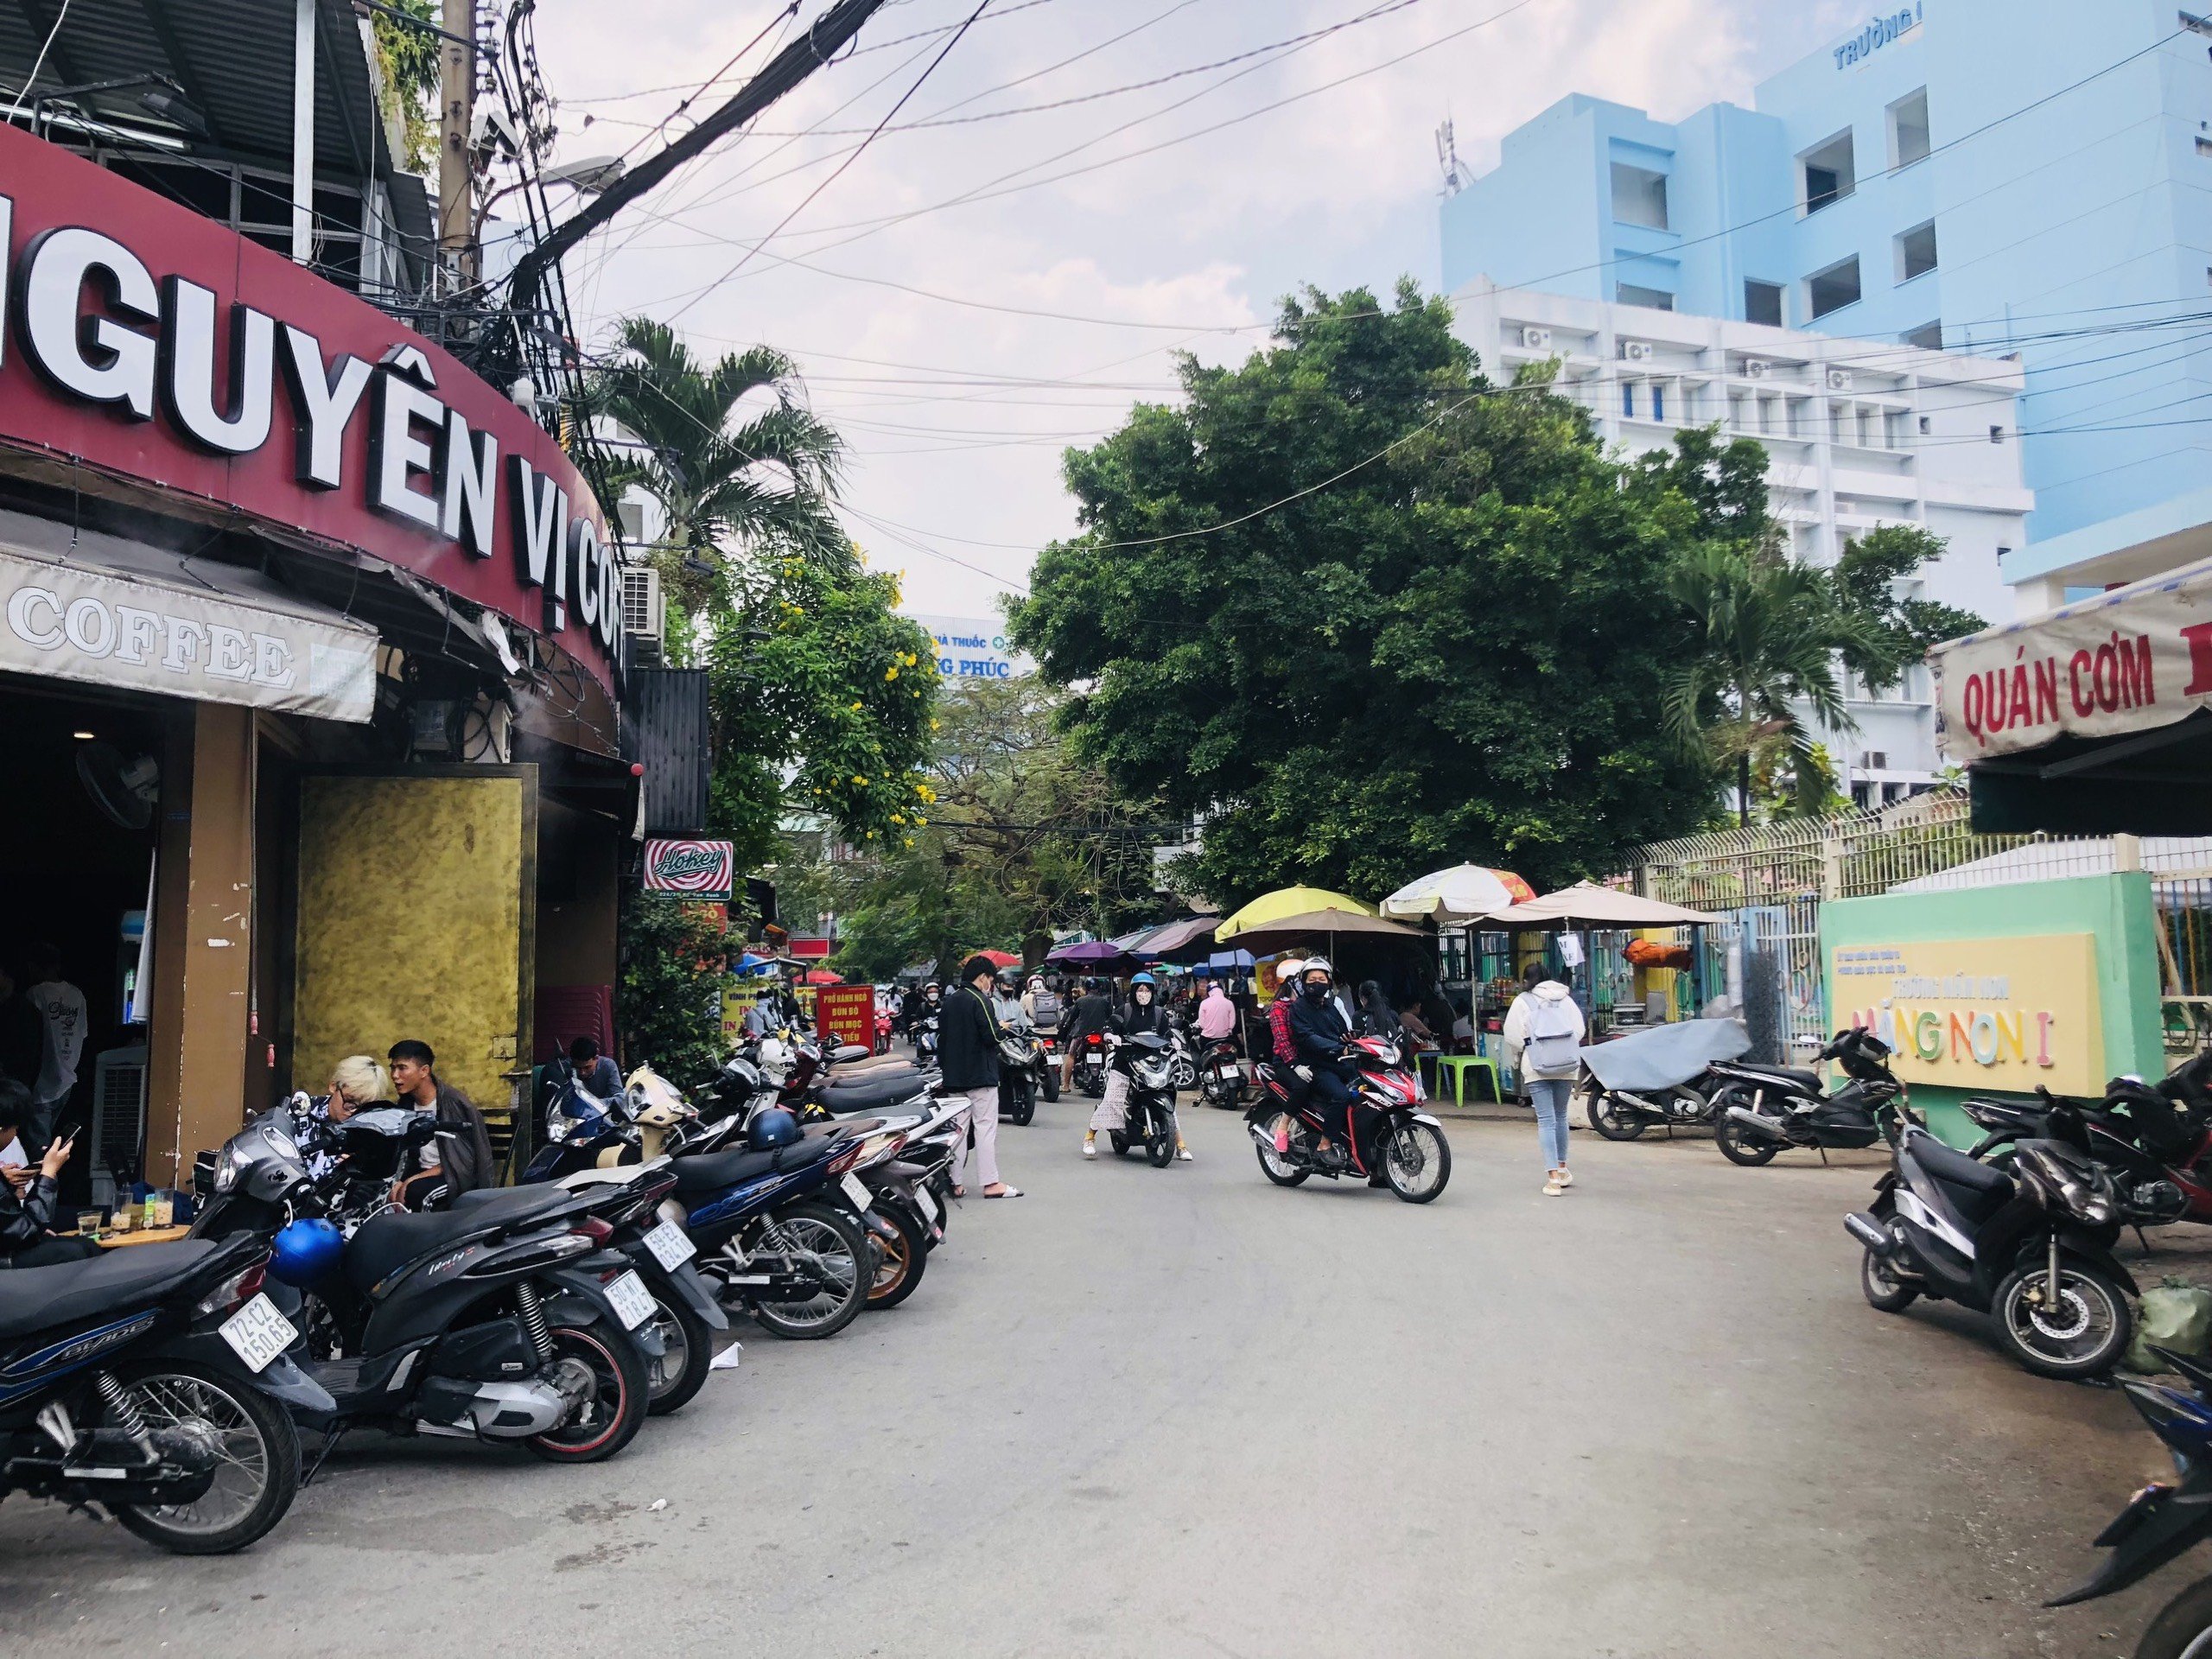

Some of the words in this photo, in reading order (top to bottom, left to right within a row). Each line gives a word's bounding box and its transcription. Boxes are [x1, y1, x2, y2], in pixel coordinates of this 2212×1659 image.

[0, 195, 499, 558] GUYÊN
[506, 454, 569, 632] VỊ
[7, 586, 297, 690] COFFEE
[951, 633, 987, 648] THUỐC
[958, 657, 1009, 678] PHÚC
[1963, 645, 2059, 747] QUÁN
[2069, 630, 2155, 718] CƠM
[654, 847, 726, 874] Hokey
[1949, 1009, 2025, 1065] NON
[2037, 1011, 2052, 1065] I
[228, 1301, 272, 1344] 72-C2
[244, 1317, 292, 1365] 150.65
